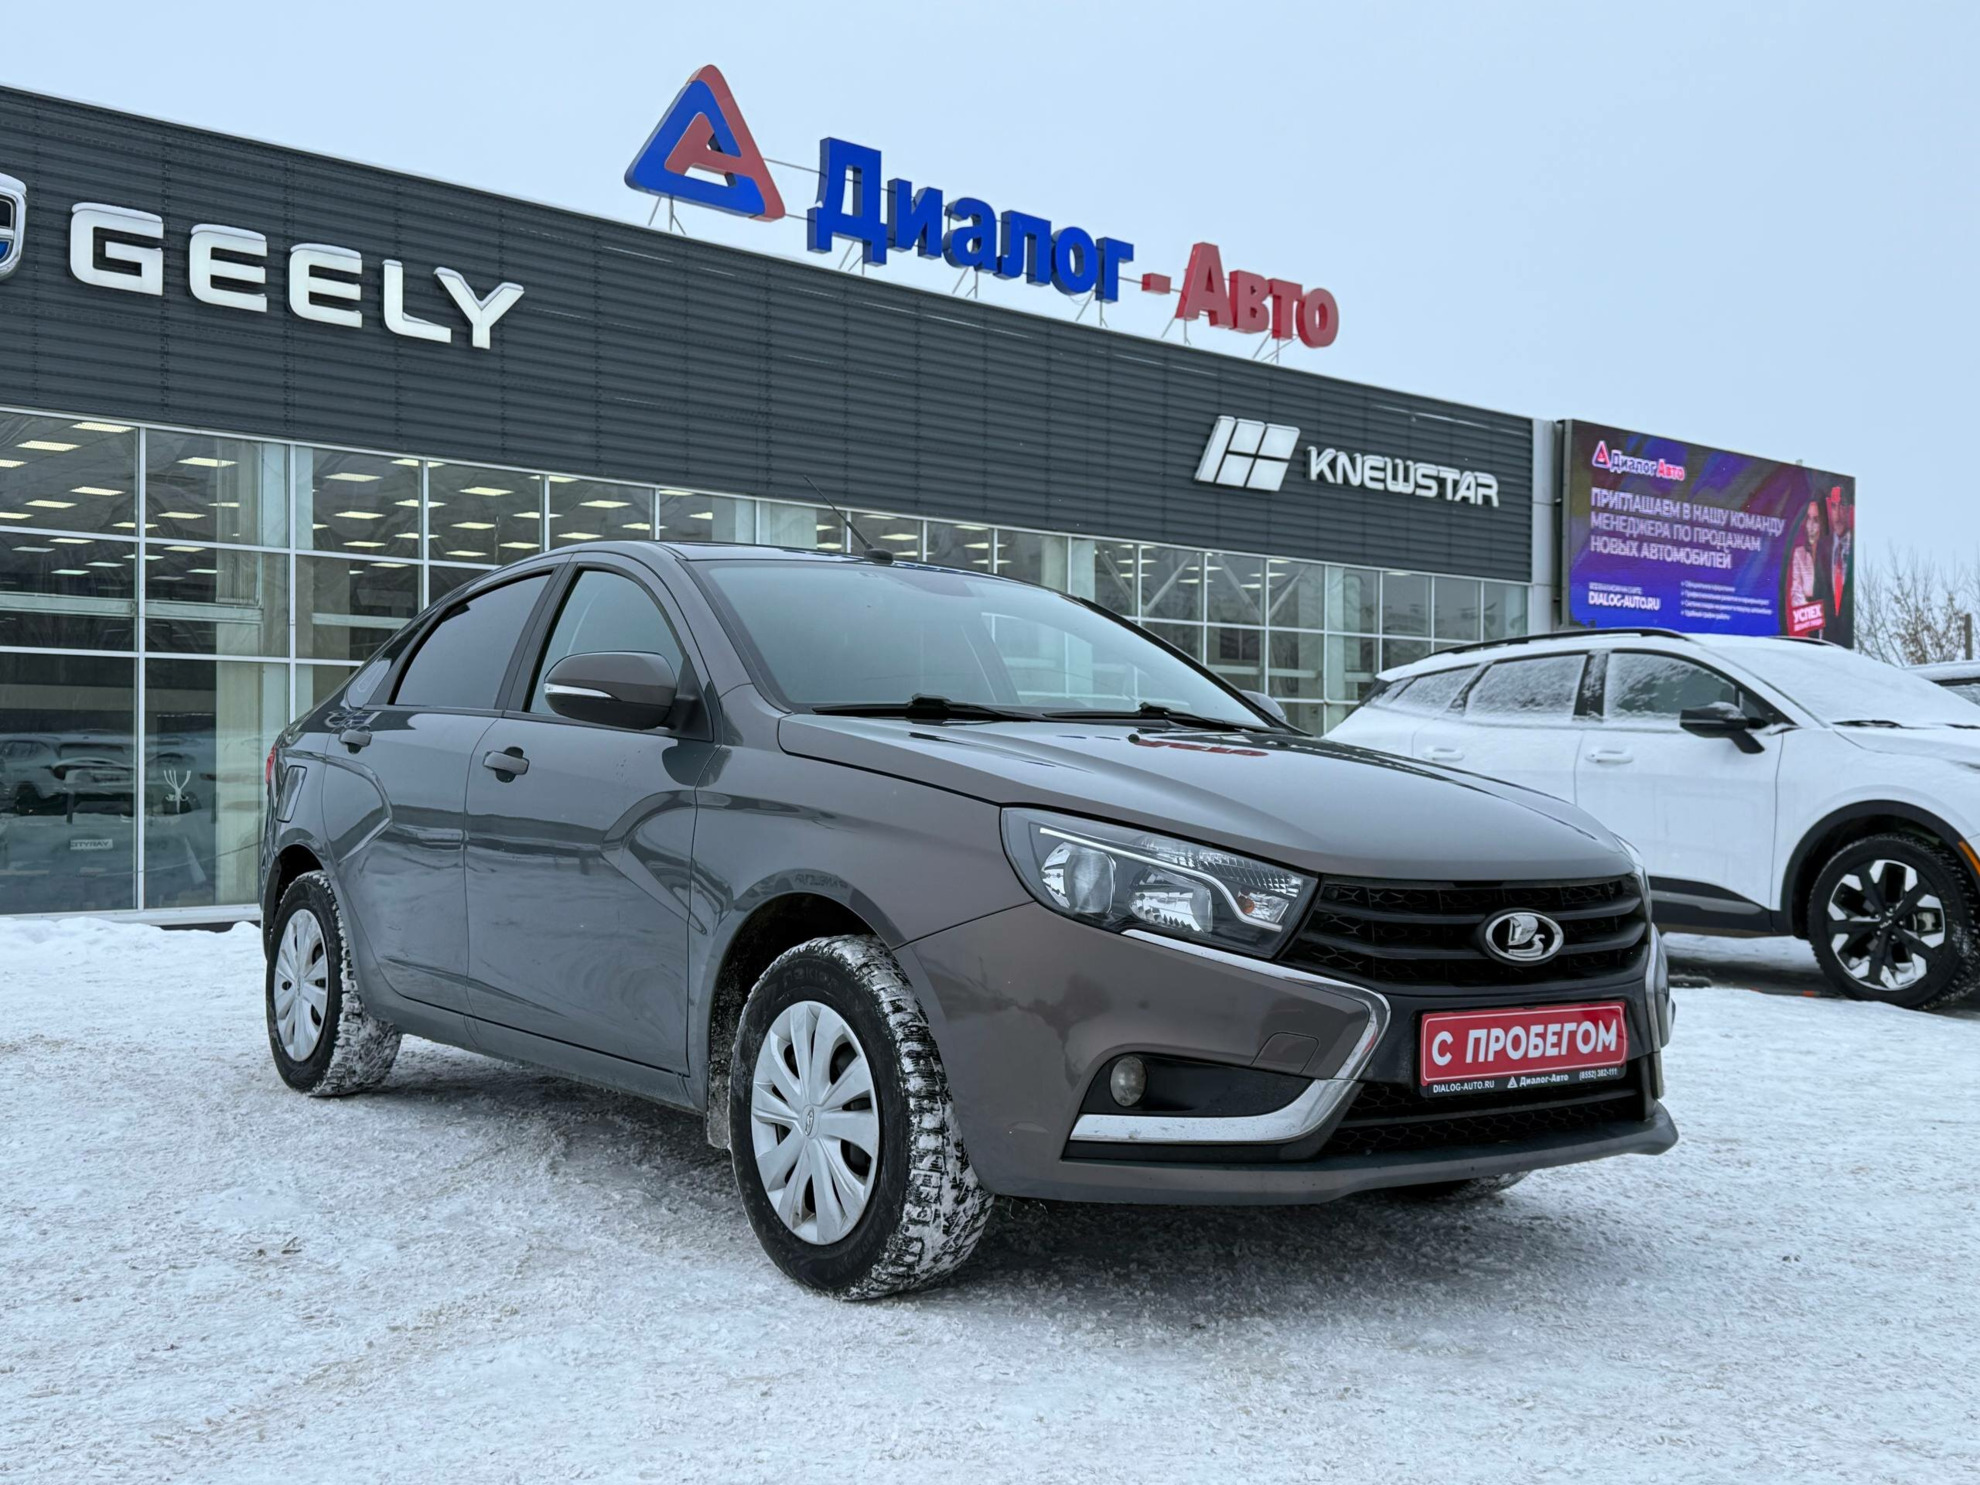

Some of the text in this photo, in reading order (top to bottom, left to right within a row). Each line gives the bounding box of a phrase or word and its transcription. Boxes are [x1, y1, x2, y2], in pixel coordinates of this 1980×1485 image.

[69, 202, 524, 350] GEELY
[1307, 445, 1500, 507] KNEWSTAR
[1591, 487, 1786, 537] ПРИГЛАШАЕМ В НАШУ КОМАНДУ
[1591, 511, 1761, 551] МЕНЕДЖЕРА ПО ПРОДАЖАМ
[1590, 535, 1732, 569] НОВЫХ АВТОМОБИЛЕЙ
[1588, 591, 1661, 610] DIALOG-AUTO.RU
[1792, 604, 1822, 623] УСПЕХ
[1431, 1018, 1617, 1066] С ПРОБЕГОМ
[1432, 1080, 1495, 1093] DIALOG-AUTO.RU
[1519, 1073, 1569, 1087] Диалог-Авто
